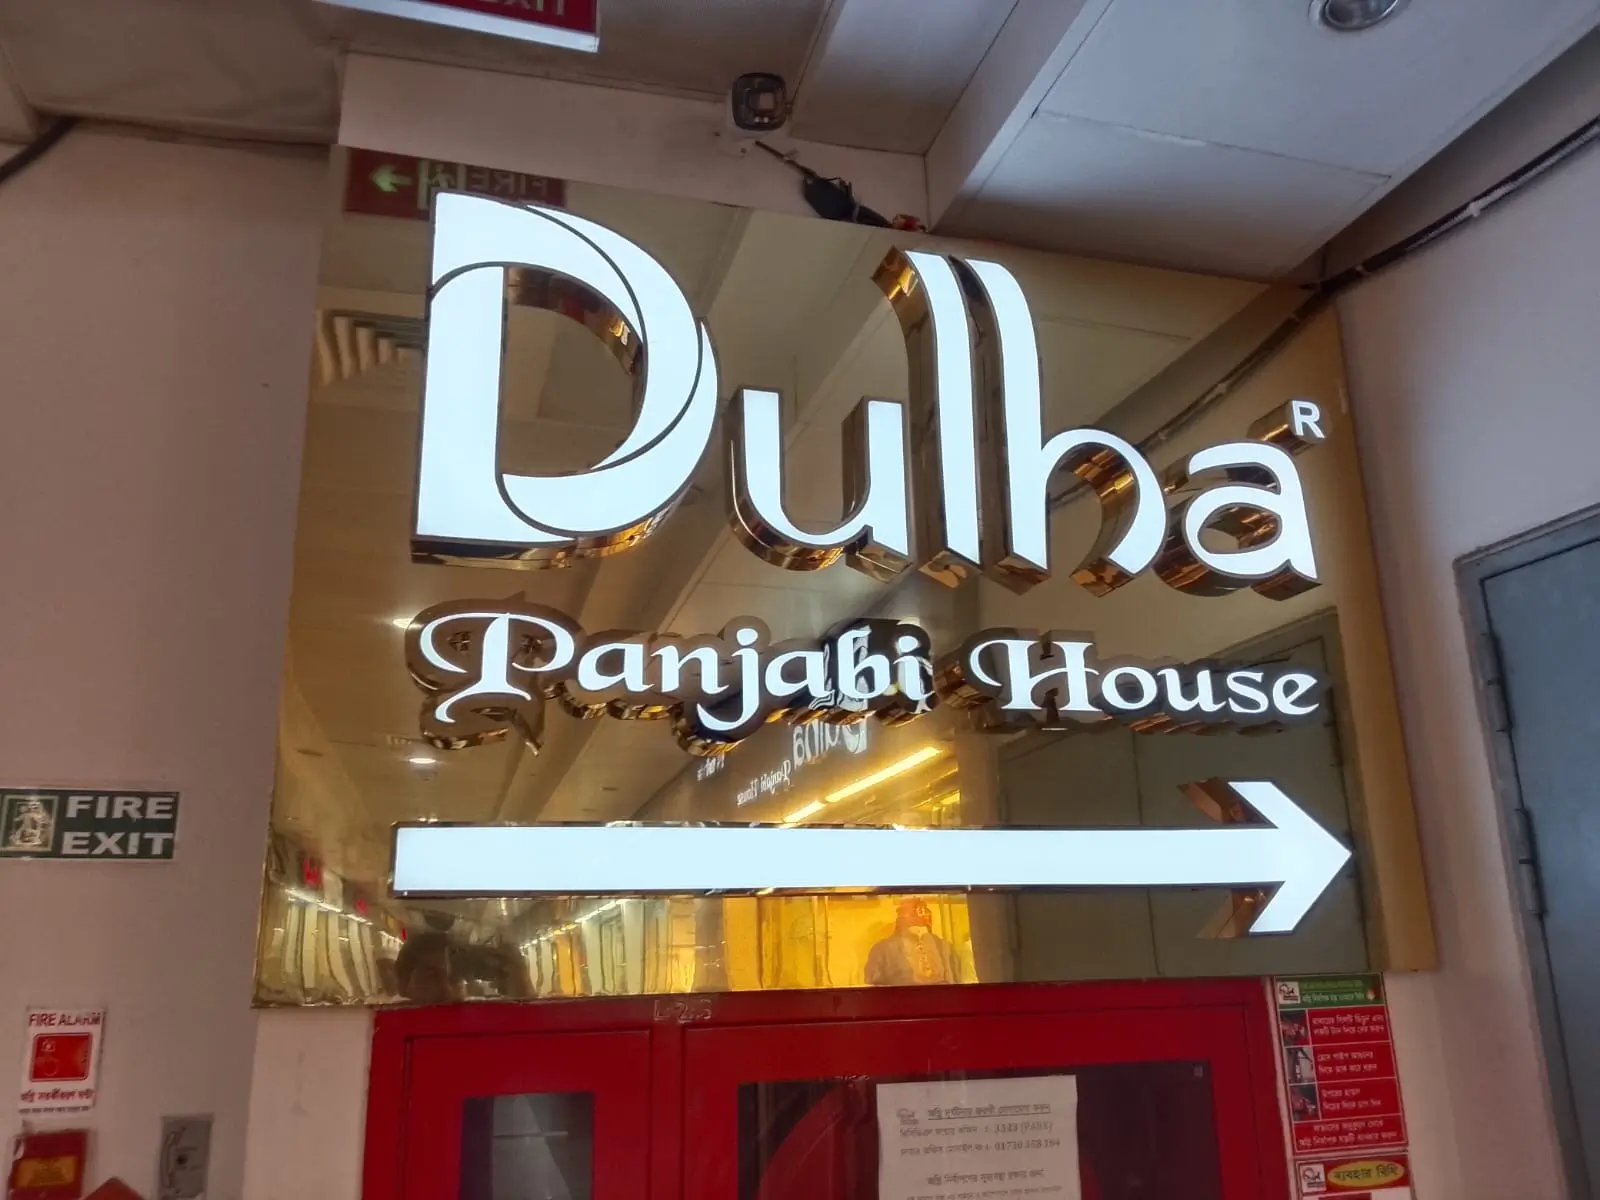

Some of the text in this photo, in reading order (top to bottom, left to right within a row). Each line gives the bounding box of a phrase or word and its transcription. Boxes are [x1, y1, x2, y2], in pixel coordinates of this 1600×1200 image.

[416, 191, 1318, 580] Dulha
[419, 612, 1320, 731] Panjabi House
[66, 795, 175, 820] FIRE
[61, 831, 174, 856] EXIT
[29, 1012, 57, 1027] FIRE
